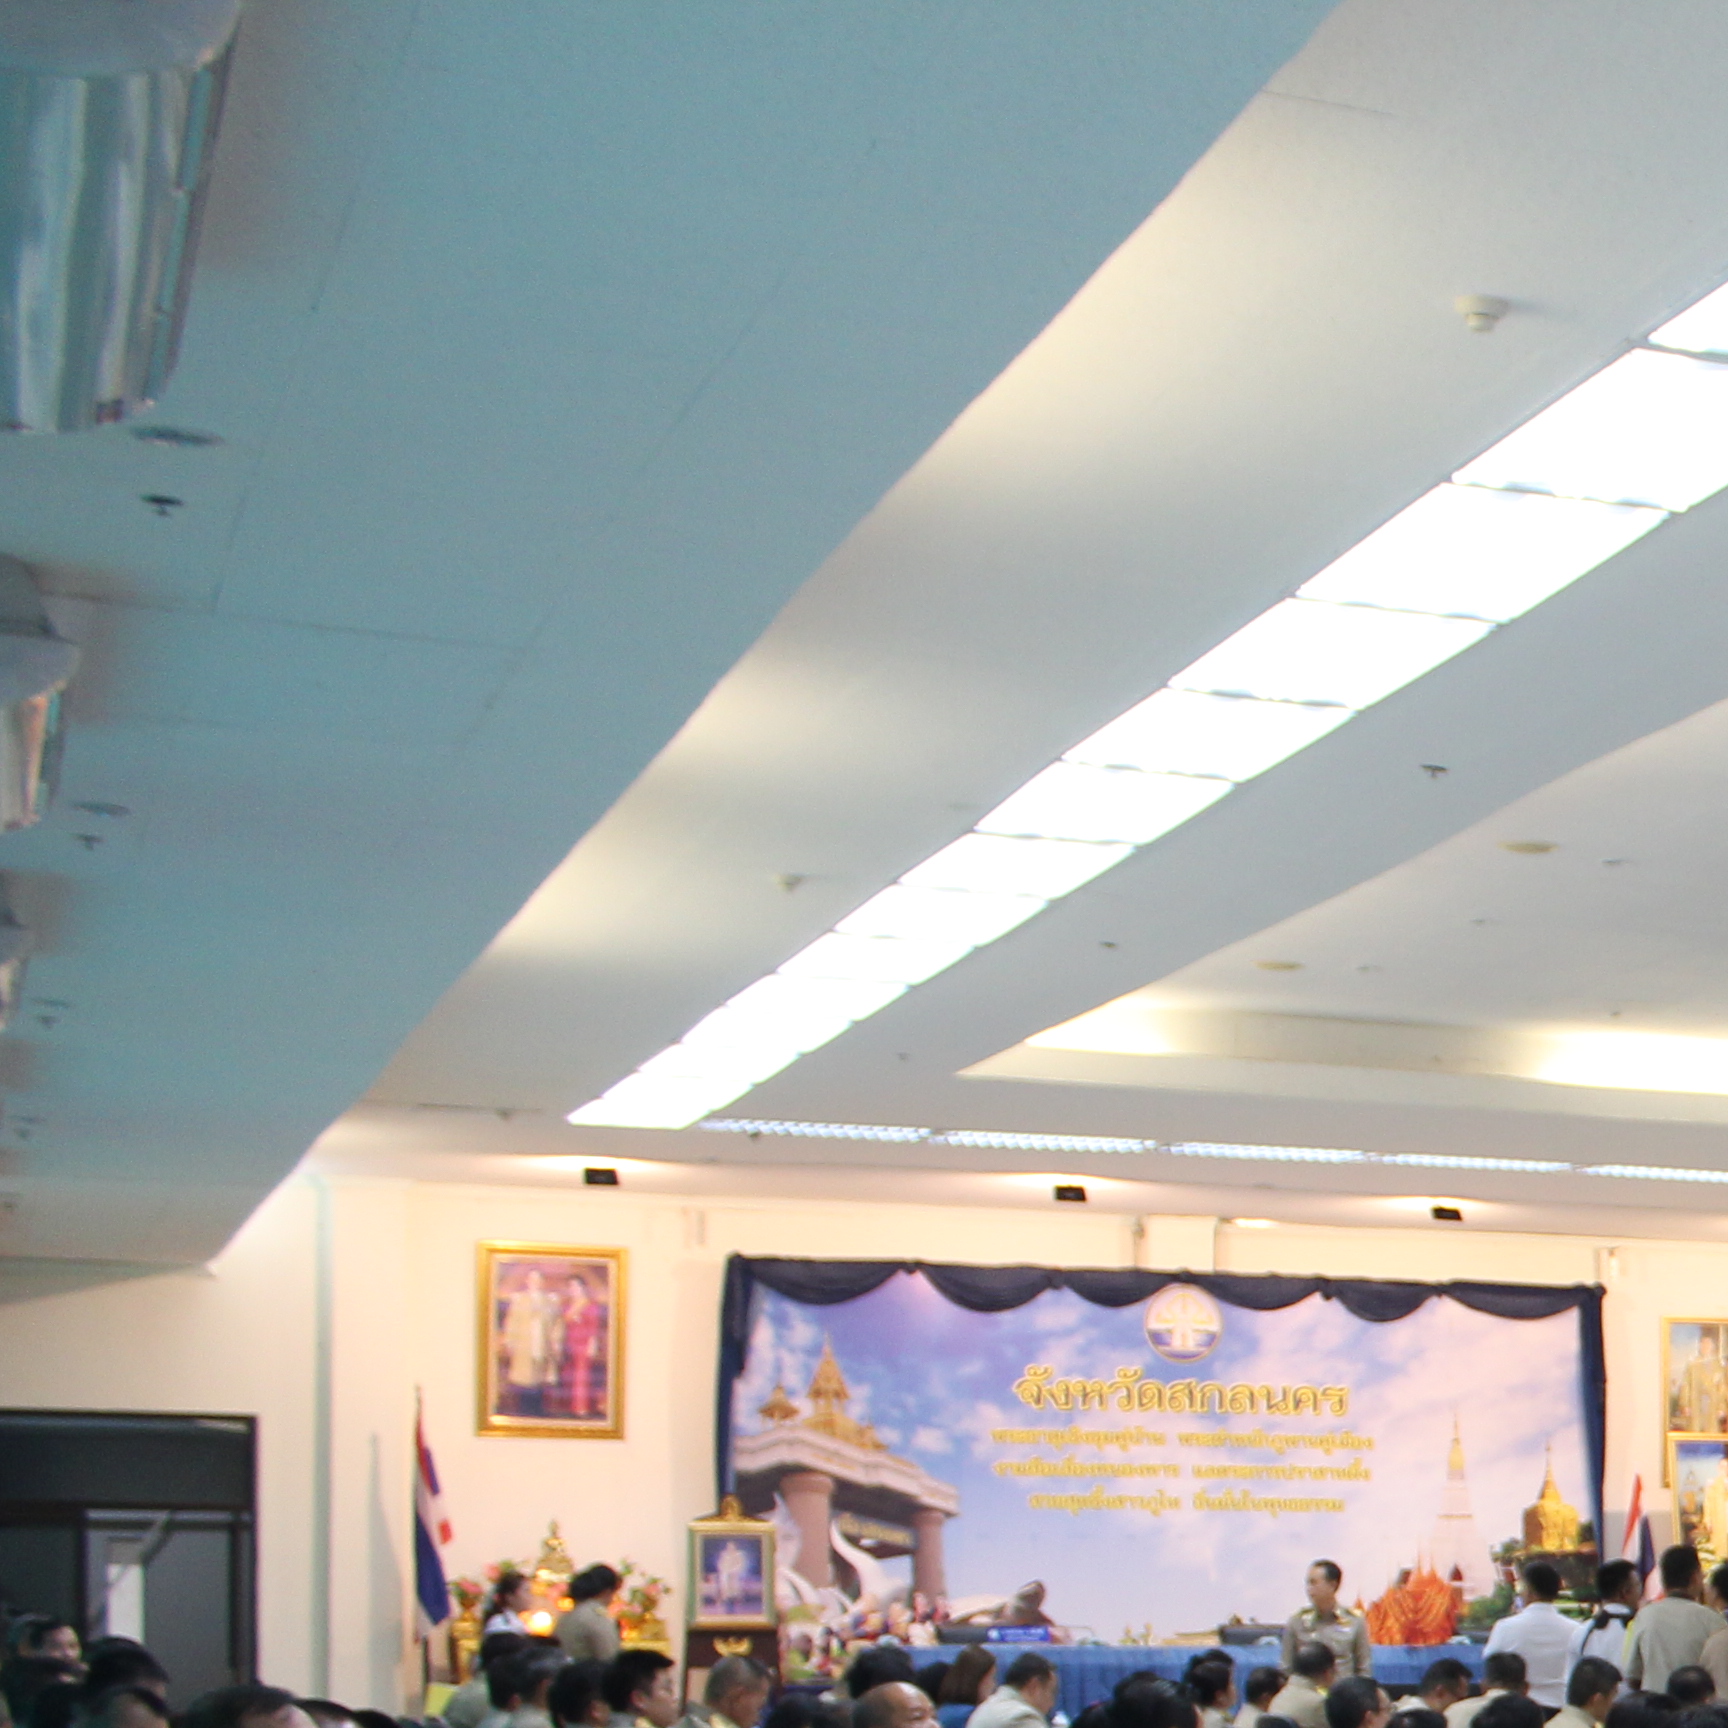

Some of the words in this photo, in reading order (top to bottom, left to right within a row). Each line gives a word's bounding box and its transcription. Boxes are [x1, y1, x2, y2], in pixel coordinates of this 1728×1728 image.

[1013, 1364, 1348, 1415] จังหวัดสกลนคร
